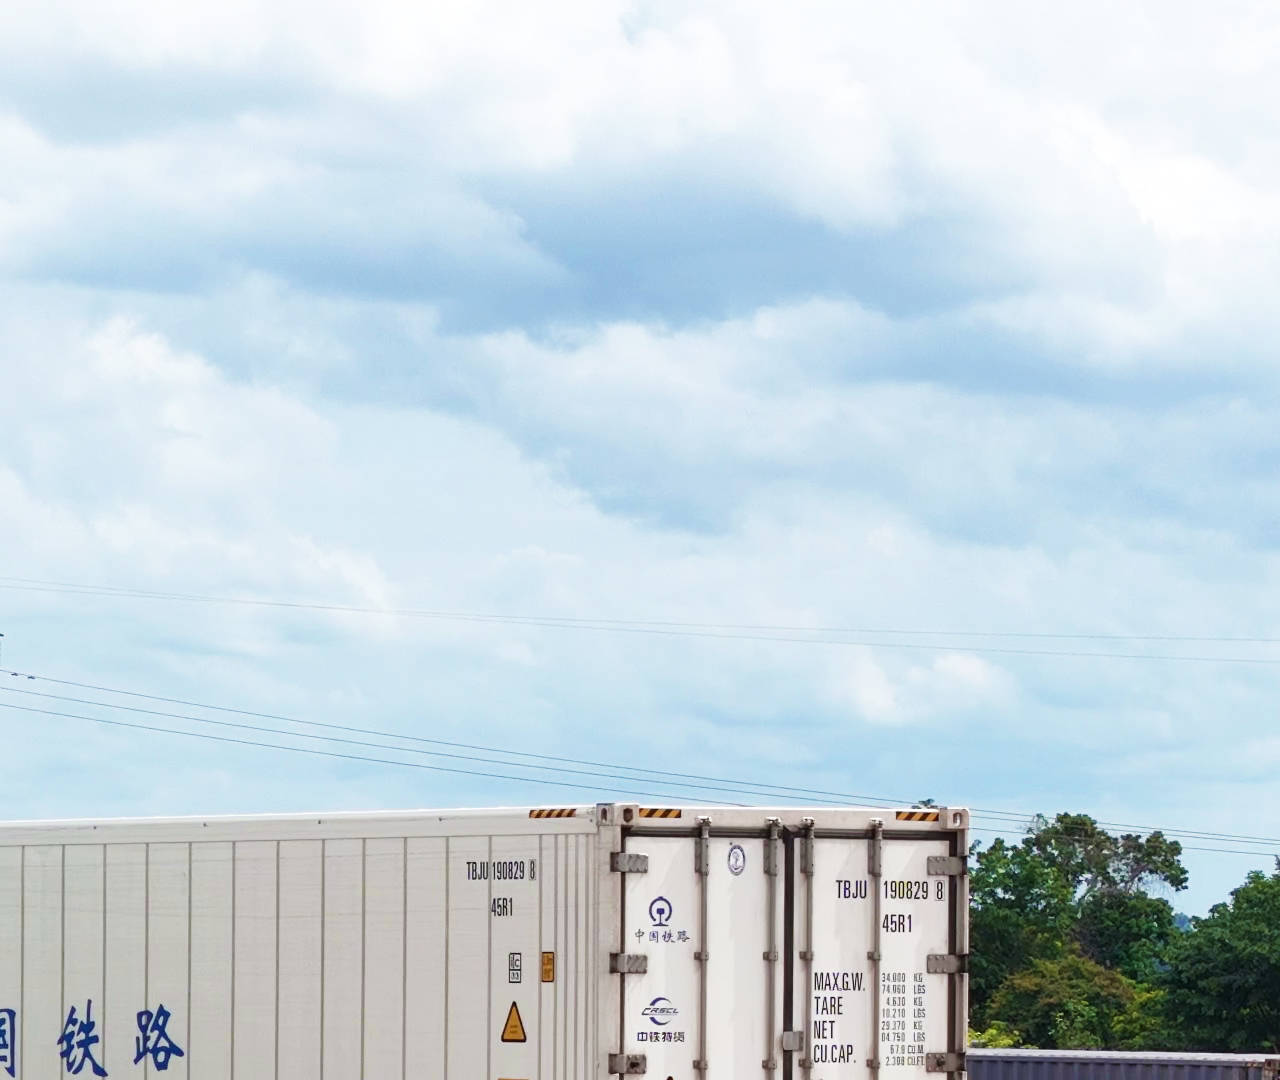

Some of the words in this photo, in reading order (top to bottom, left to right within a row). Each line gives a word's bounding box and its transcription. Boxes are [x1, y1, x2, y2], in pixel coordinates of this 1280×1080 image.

[466, 861, 489, 881] TBJU
[492, 861, 525, 881] 190829
[835, 879, 867, 899] TBJU
[883, 880, 929, 900] 190829
[936, 881, 944, 900] 8
[491, 897, 513, 917] 45R1
[882, 914, 912, 933] 45R1
[634, 928, 691, 944] 中国铁路
[814, 996, 843, 1015] TARE
[813, 1020, 835, 1039] NET
[813, 1044, 856, 1063] CU.CAP.
